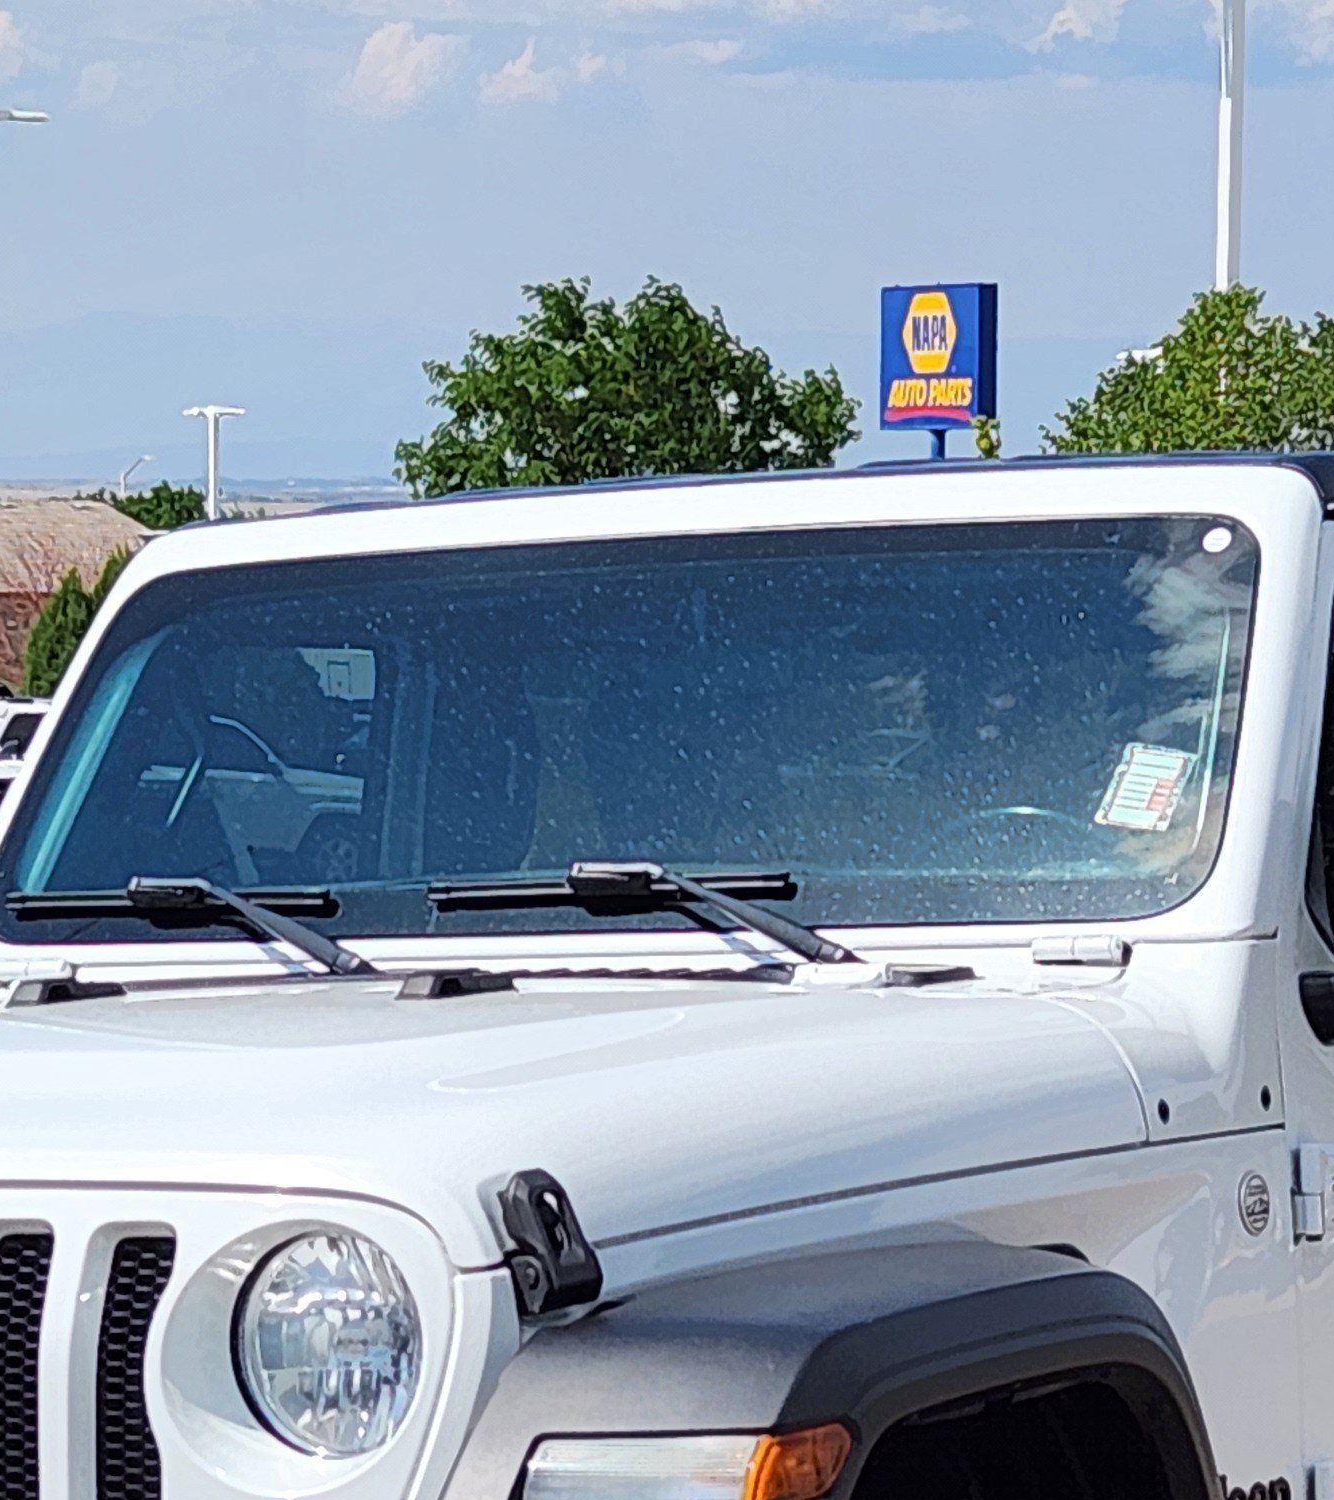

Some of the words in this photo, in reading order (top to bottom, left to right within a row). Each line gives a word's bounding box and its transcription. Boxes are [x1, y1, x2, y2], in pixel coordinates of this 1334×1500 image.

[912, 315, 947, 351] NAPA
[888, 379, 927, 408] AUTO
[928, 377, 973, 406] PARTS
